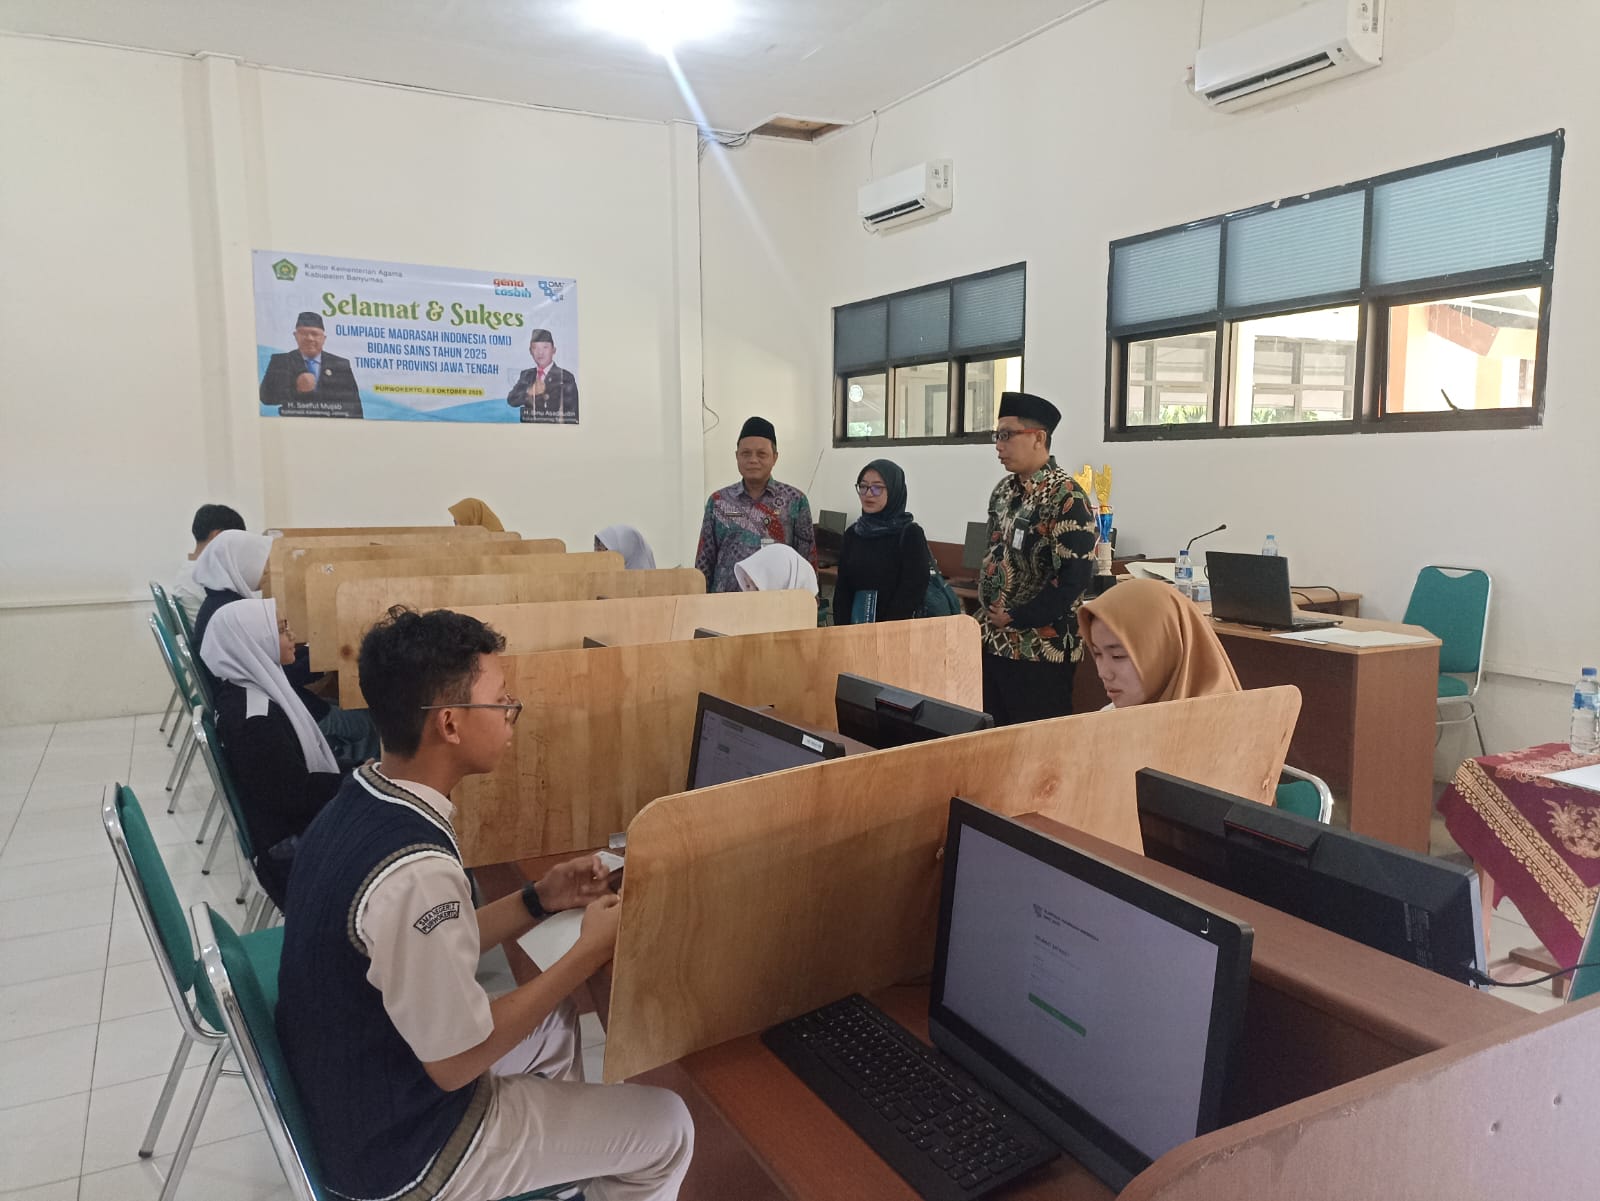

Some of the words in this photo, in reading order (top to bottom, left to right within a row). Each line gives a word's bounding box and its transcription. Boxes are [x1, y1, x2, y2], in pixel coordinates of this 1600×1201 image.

[378, 269, 403, 278] Agama
[322, 292, 420, 320] Selamat
[426, 300, 444, 322] &
[450, 302, 524, 330] Sukses
[336, 324, 386, 338] OLIMPIADE
[388, 328, 438, 342] MADRASAH
[441, 332, 487, 344] INDONESIA
[489, 335, 512, 346] (OMI)
[368, 342, 402, 355] BIDANG
[404, 344, 430, 356] SAINS
[433, 346, 462, 358] TAHUN
[464, 348, 486, 360] 2025
[355, 357, 394, 370] TINGKAT
[397, 360, 438, 372] PROVINSI
[440, 362, 464, 373] JAWA
[465, 363, 498, 374] TENGAH
